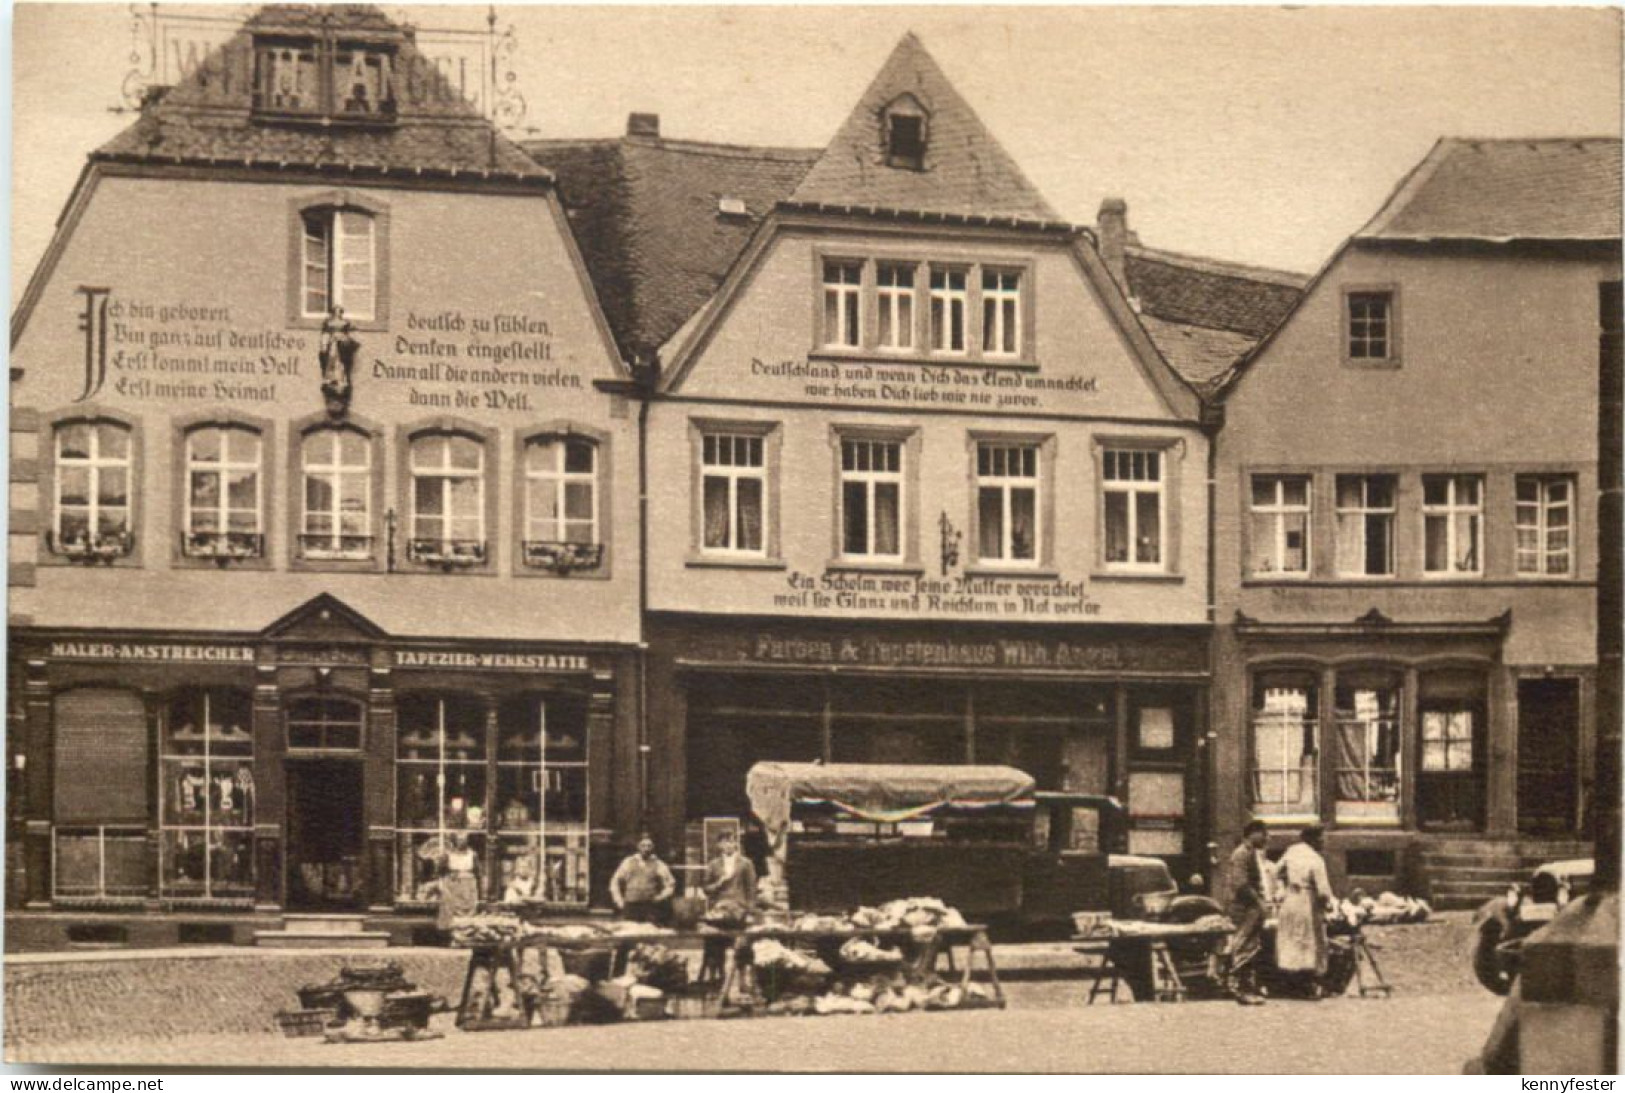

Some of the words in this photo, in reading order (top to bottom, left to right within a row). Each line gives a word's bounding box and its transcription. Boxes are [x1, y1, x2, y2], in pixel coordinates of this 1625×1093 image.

[128, 303, 155, 319] bin
[407, 312, 465, 334] deutsch
[470, 319, 490, 335] zu
[229, 331, 306, 351] deutsches
[395, 335, 458, 358] Denken
[213, 357, 257, 375] mein
[154, 382, 208, 400] meine
[409, 387, 451, 406] dann
[454, 389, 480, 409] die
[51, 642, 255, 661] MALER-ANSTREICHER
